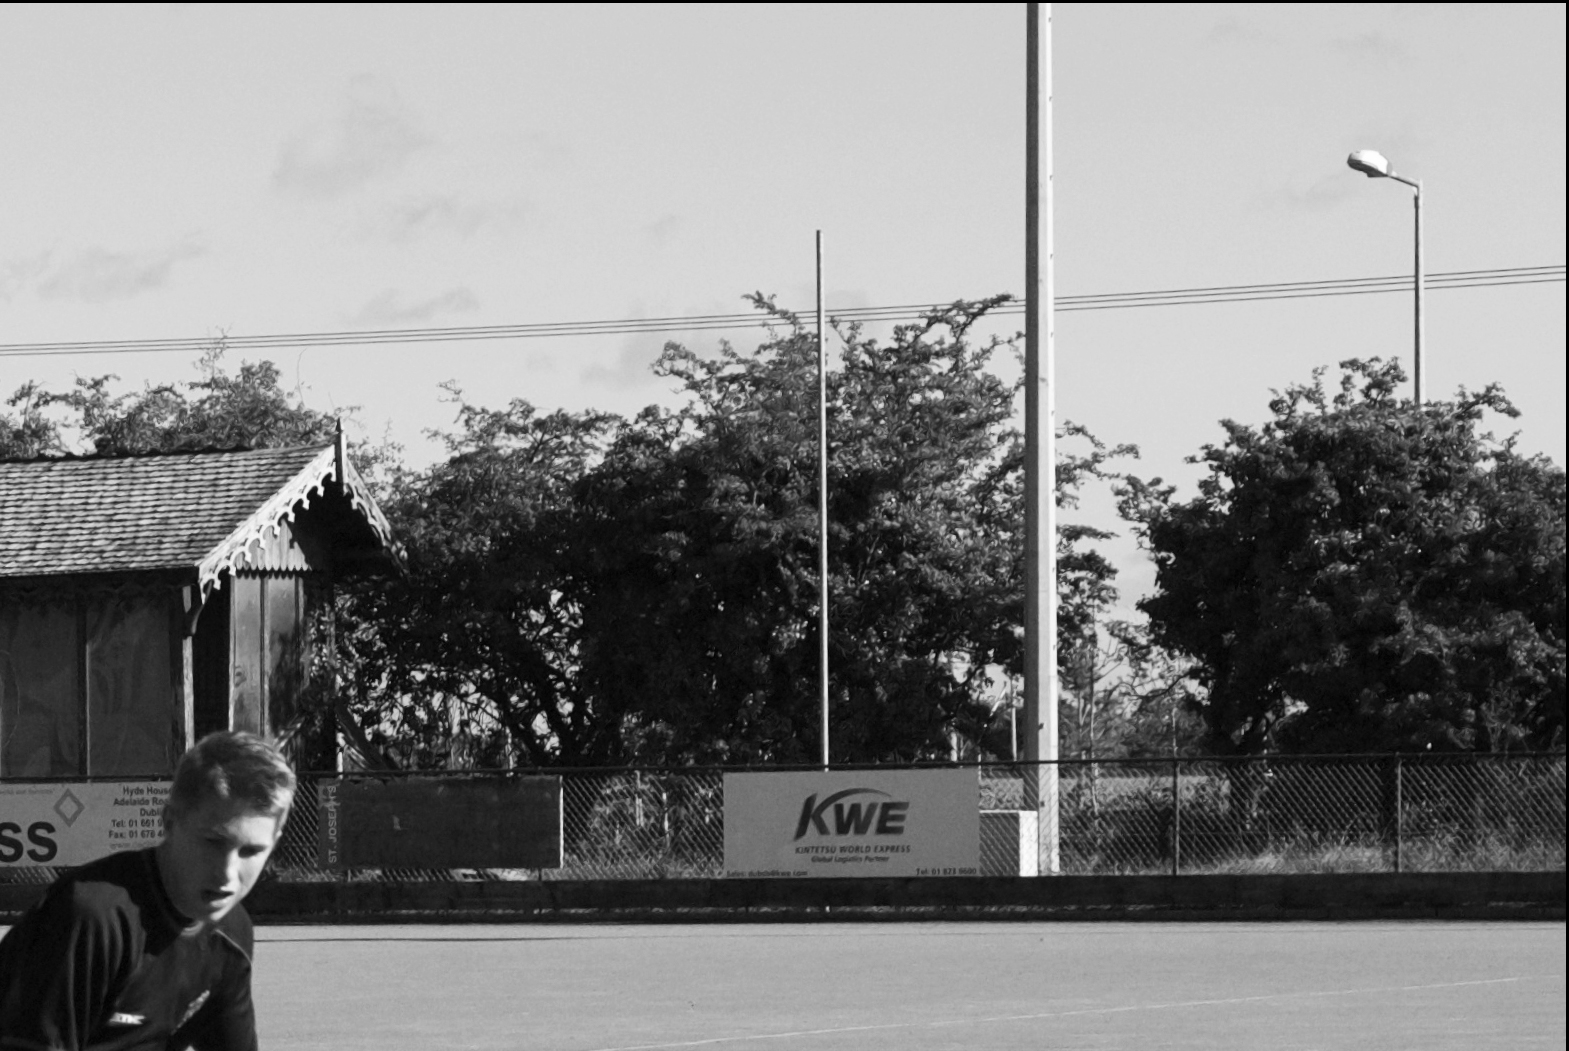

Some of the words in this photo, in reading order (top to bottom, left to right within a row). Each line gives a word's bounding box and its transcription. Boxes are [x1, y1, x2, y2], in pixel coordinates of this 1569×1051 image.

[122, 786, 145, 797] Hyde
[113, 797, 150, 806] Adelaide
[793, 788, 910, 841] KWE
[128, 819, 138, 828] 01
[129, 829, 138, 839] 01
[795, 845, 837, 854] KINTETSU
[839, 845, 872, 854] WORLD
[874, 844, 912, 853] EXPRESS
[931, 867, 941, 876] 01
